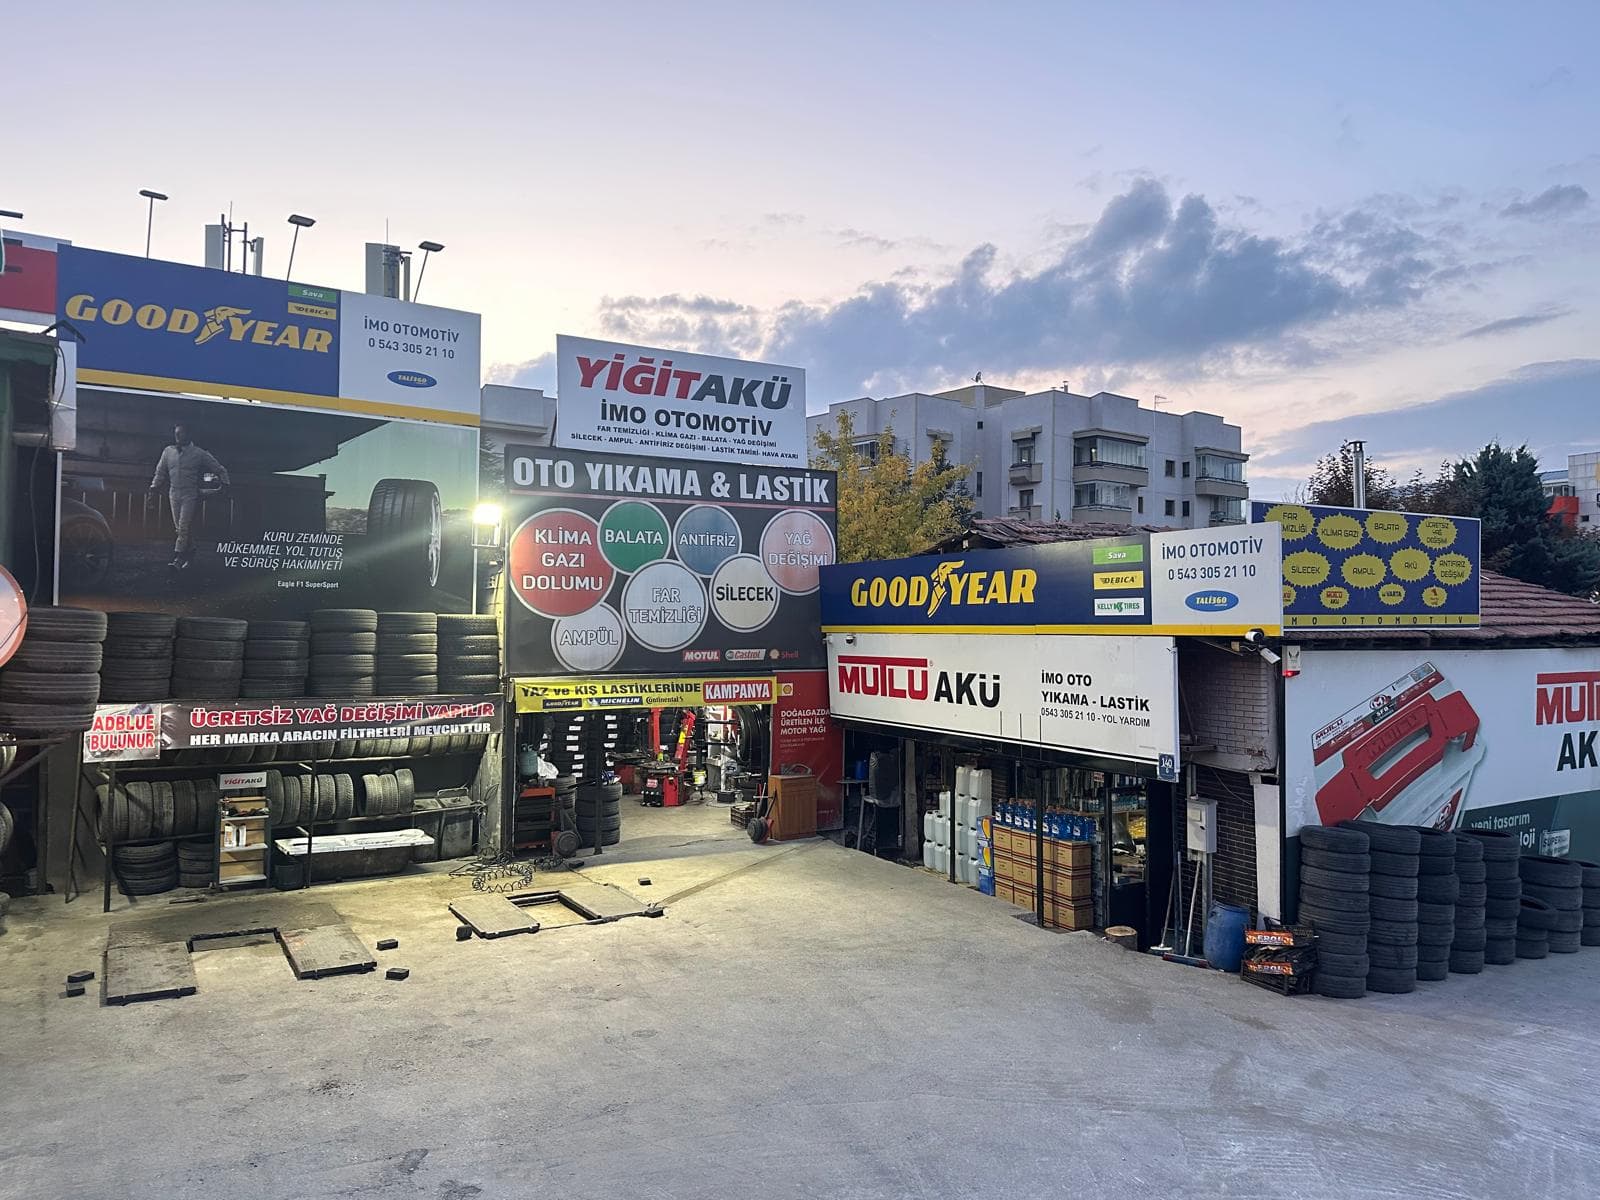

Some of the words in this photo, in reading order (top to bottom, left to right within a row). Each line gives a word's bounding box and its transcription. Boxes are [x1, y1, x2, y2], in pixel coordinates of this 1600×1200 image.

[302, 289, 324, 299] Sava
[364, 315, 389, 332] İMO
[393, 323, 459, 343] OTOMOTİV
[368, 338, 375, 348] 0
[378, 339, 399, 351] 543
[402, 342, 422, 354] 305
[425, 346, 437, 357] 21
[443, 348, 455, 359] 10
[601, 399, 646, 424] İMO
[654, 408, 772, 437] OTOMOTİV
[597, 425, 611, 433] FAR
[656, 430, 677, 439] KLİMA
[680, 432, 696, 440] GAZI
[702, 435, 727, 443] BALATA
[733, 437, 746, 445] YAĞ
[571, 432, 602, 442] SİLECEK
[712, 445, 735, 454] LASTİK
[780, 452, 799, 460] AYARI
[513, 457, 575, 488] OTO
[585, 462, 702, 497] YIKAMA
[711, 471, 731, 498] &
[739, 472, 830, 504] LASTİK
[1282, 512, 1298, 520] FAR
[263, 531, 295, 543] KURU
[296, 532, 344, 545] ZEMİNDE
[535, 526, 592, 546] KLİMA
[605, 529, 664, 545] BALATA
[679, 531, 736, 548] ANTİFRİZ
[784, 530, 812, 546] YAĞ
[216, 541, 281, 556] MÜKEMMEL
[285, 545, 305, 557] YOL
[309, 546, 343, 559] TUTUŞ
[1107, 551, 1127, 560] Sava
[1162, 543, 1186, 560] İMO
[1189, 535, 1263, 558] OTOMOTİV
[224, 556, 238, 568] VE
[240, 556, 280, 571] SÜRÜŞ
[281, 558, 343, 571] HAKİMİYETİ
[541, 553, 585, 568] GAZI
[768, 550, 828, 569] DEĞİŞİMİ
[1168, 569, 1175, 580] 0
[1177, 568, 1197, 580] 543
[1200, 567, 1221, 579] 305
[1224, 566, 1237, 578] 21
[1242, 565, 1256, 577] 10
[277, 580, 295, 589] Eagle
[296, 580, 304, 588] F1
[305, 581, 339, 589] SuperSport
[522, 574, 603, 591] DOLUMU
[652, 588, 680, 603] FAR
[715, 584, 775, 602] SİLECEK
[1096, 602, 1113, 610] KELLY
[1123, 602, 1140, 610] TIRES
[629, 605, 702, 625] TEMİZLİĞİ
[560, 625, 618, 646] AMPÜL
[684, 651, 719, 661] MOTUL
[734, 650, 761, 659] Castrol
[838, 655, 928, 700] MUTLU
[934, 671, 1000, 708] AKÜ
[1041, 669, 1063, 685] İMO
[1067, 674, 1092, 686] OTO
[554, 687, 570, 695] ve
[575, 685, 597, 695] KIŞ
[602, 682, 701, 694] LASTİKLERİNDE
[705, 683, 770, 700] KAMPANYA
[600, 697, 640, 706] MICHELIN
[645, 696, 679, 705] Continental
[1041, 691, 1089, 706] YIKAMA
[1100, 695, 1150, 711] LASTİK
[190, 706, 292, 728] ÜCRETSİZ
[297, 704, 336, 724] YAĞ
[341, 702, 423, 724] DEĞİŞİMİ
[427, 703, 495, 720] YAPILIR
[780, 708, 830, 717] DOĞALGAZDA
[780, 717, 813, 726] ÜRETİLEN
[814, 716, 825, 725] İLK
[1041, 707, 1058, 717] 0543
[1060, 709, 1073, 719] 305
[1075, 711, 1083, 720] 21
[1087, 712, 1096, 721] 10
[1102, 714, 1117, 724] YOL
[1119, 716, 1150, 727] YARDIM
[93, 714, 155, 732] ADBLUE
[780, 727, 807, 735] MOTOR
[809, 725, 826, 734] YAĞI
[90, 732, 155, 751] BULUNUR
[190, 734, 220, 746] HER
[224, 731, 280, 745] MARKA
[283, 729, 338, 742] ARACIN
[340, 725, 411, 739] FİLTRELERİ
[413, 723, 491, 736] MEVCUTTUR
[1557, 731, 1599, 771] AK
[1493, 813, 1530, 829] tasarım
[1519, 828, 1535, 848] loji
